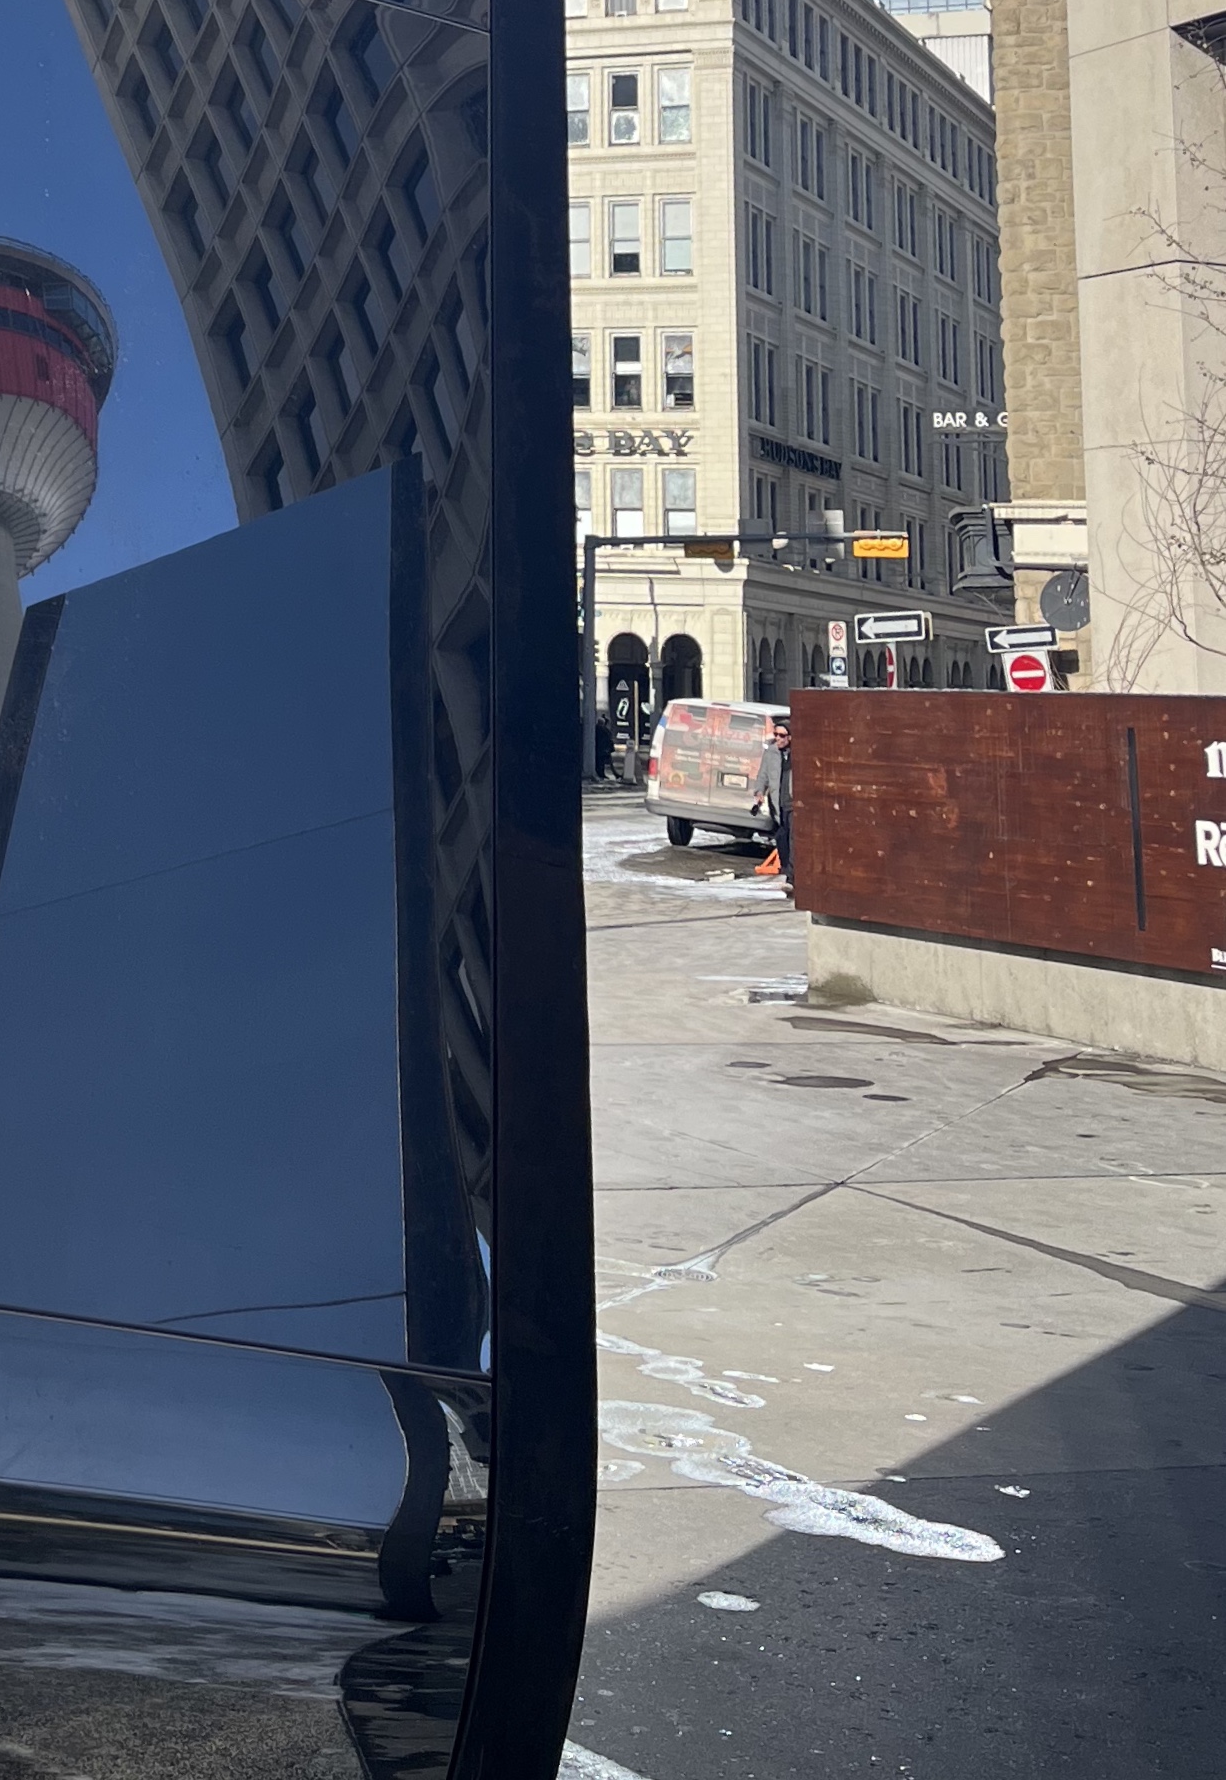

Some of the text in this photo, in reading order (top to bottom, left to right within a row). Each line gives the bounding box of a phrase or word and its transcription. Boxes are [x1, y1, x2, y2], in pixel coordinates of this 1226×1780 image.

[932, 411, 1009, 428] BAR & G
[607, 430, 694, 457] BAY
[1195, 819, 1226, 867] R
